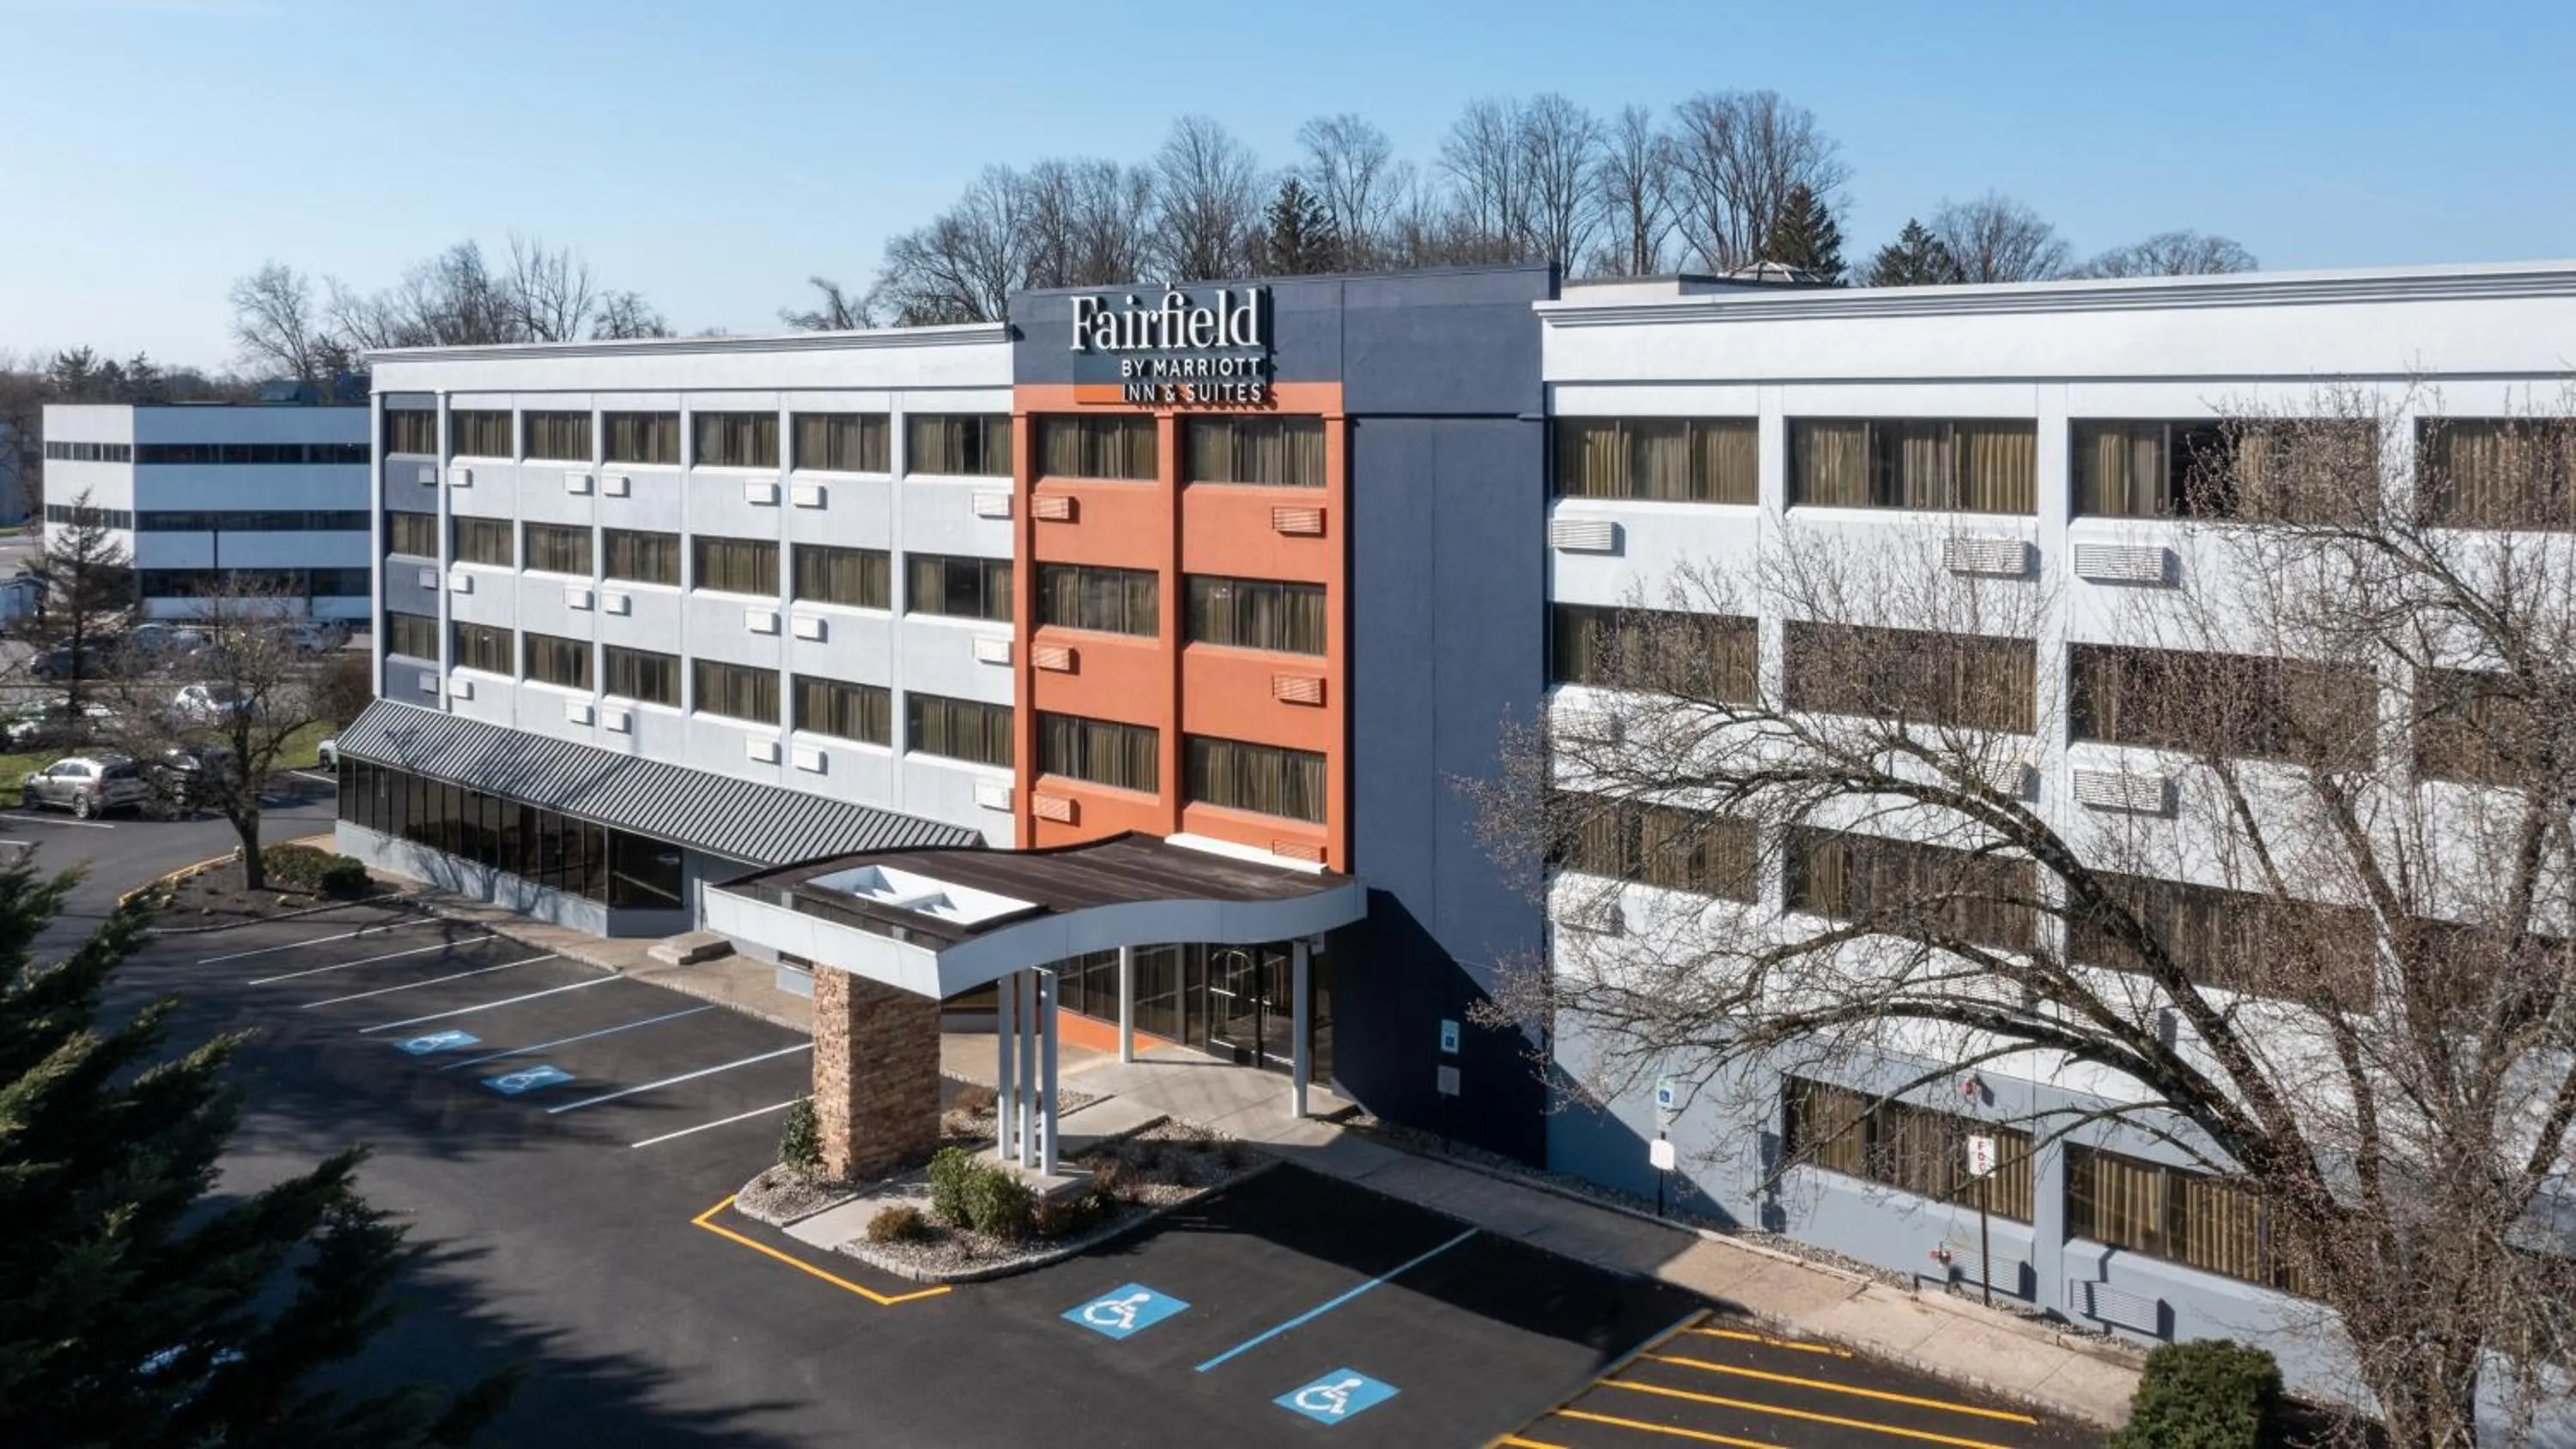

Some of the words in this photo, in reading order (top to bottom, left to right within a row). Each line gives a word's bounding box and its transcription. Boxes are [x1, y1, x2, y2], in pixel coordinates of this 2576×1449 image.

[1070, 282, 1261, 350] Fairfield
[1121, 360, 1145, 378] BY
[1153, 357, 1261, 378] MARRIOTT
[1121, 384, 1156, 402] INN
[1164, 383, 1182, 402] &
[1186, 383, 1262, 403] SUITES
